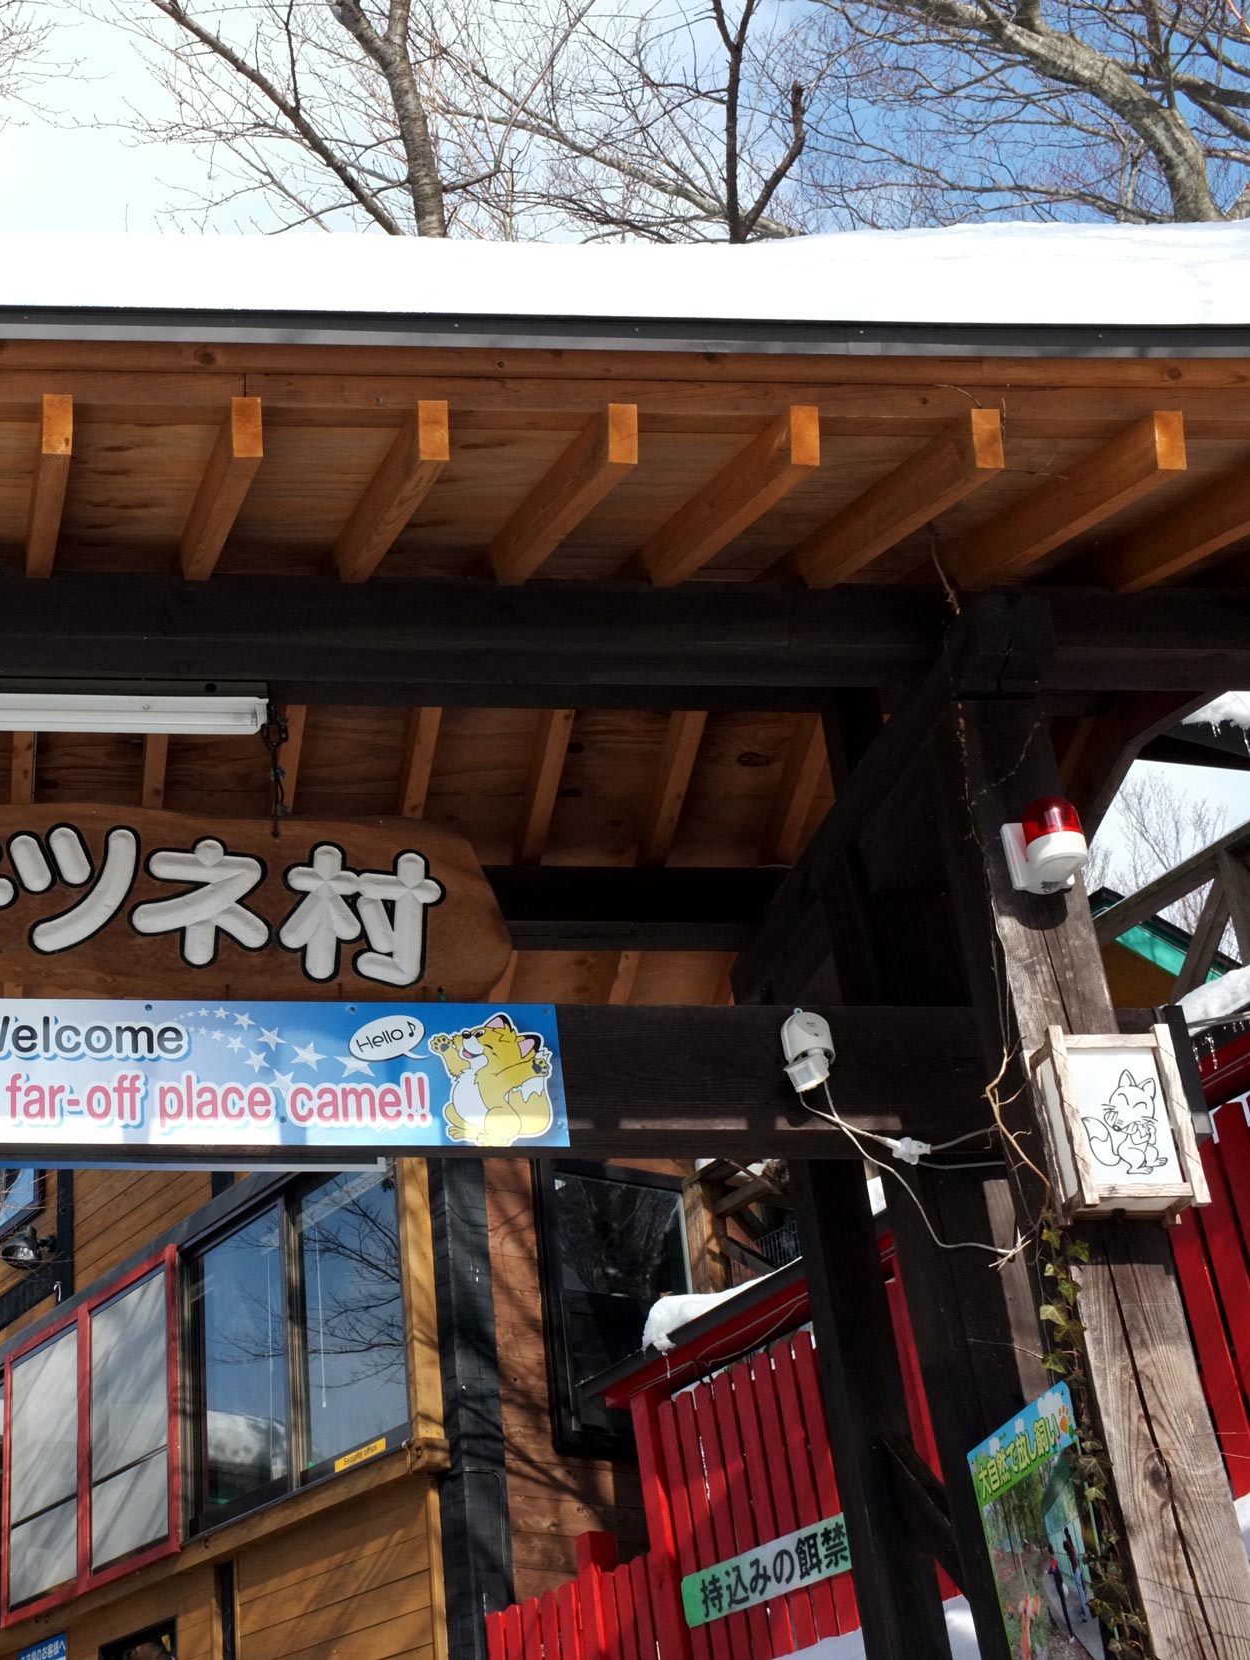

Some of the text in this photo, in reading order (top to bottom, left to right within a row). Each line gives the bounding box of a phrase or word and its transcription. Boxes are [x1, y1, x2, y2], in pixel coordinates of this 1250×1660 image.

[356, 1028, 404, 1053] Hello
[5, 1073, 141, 1121] far-off
[159, 1074, 272, 1128] place
[290, 1076, 428, 1123] came!!
[978, 1413, 1061, 1500] 大自然で放し飼い
[700, 1522, 850, 1619] 持込みの餌禁
